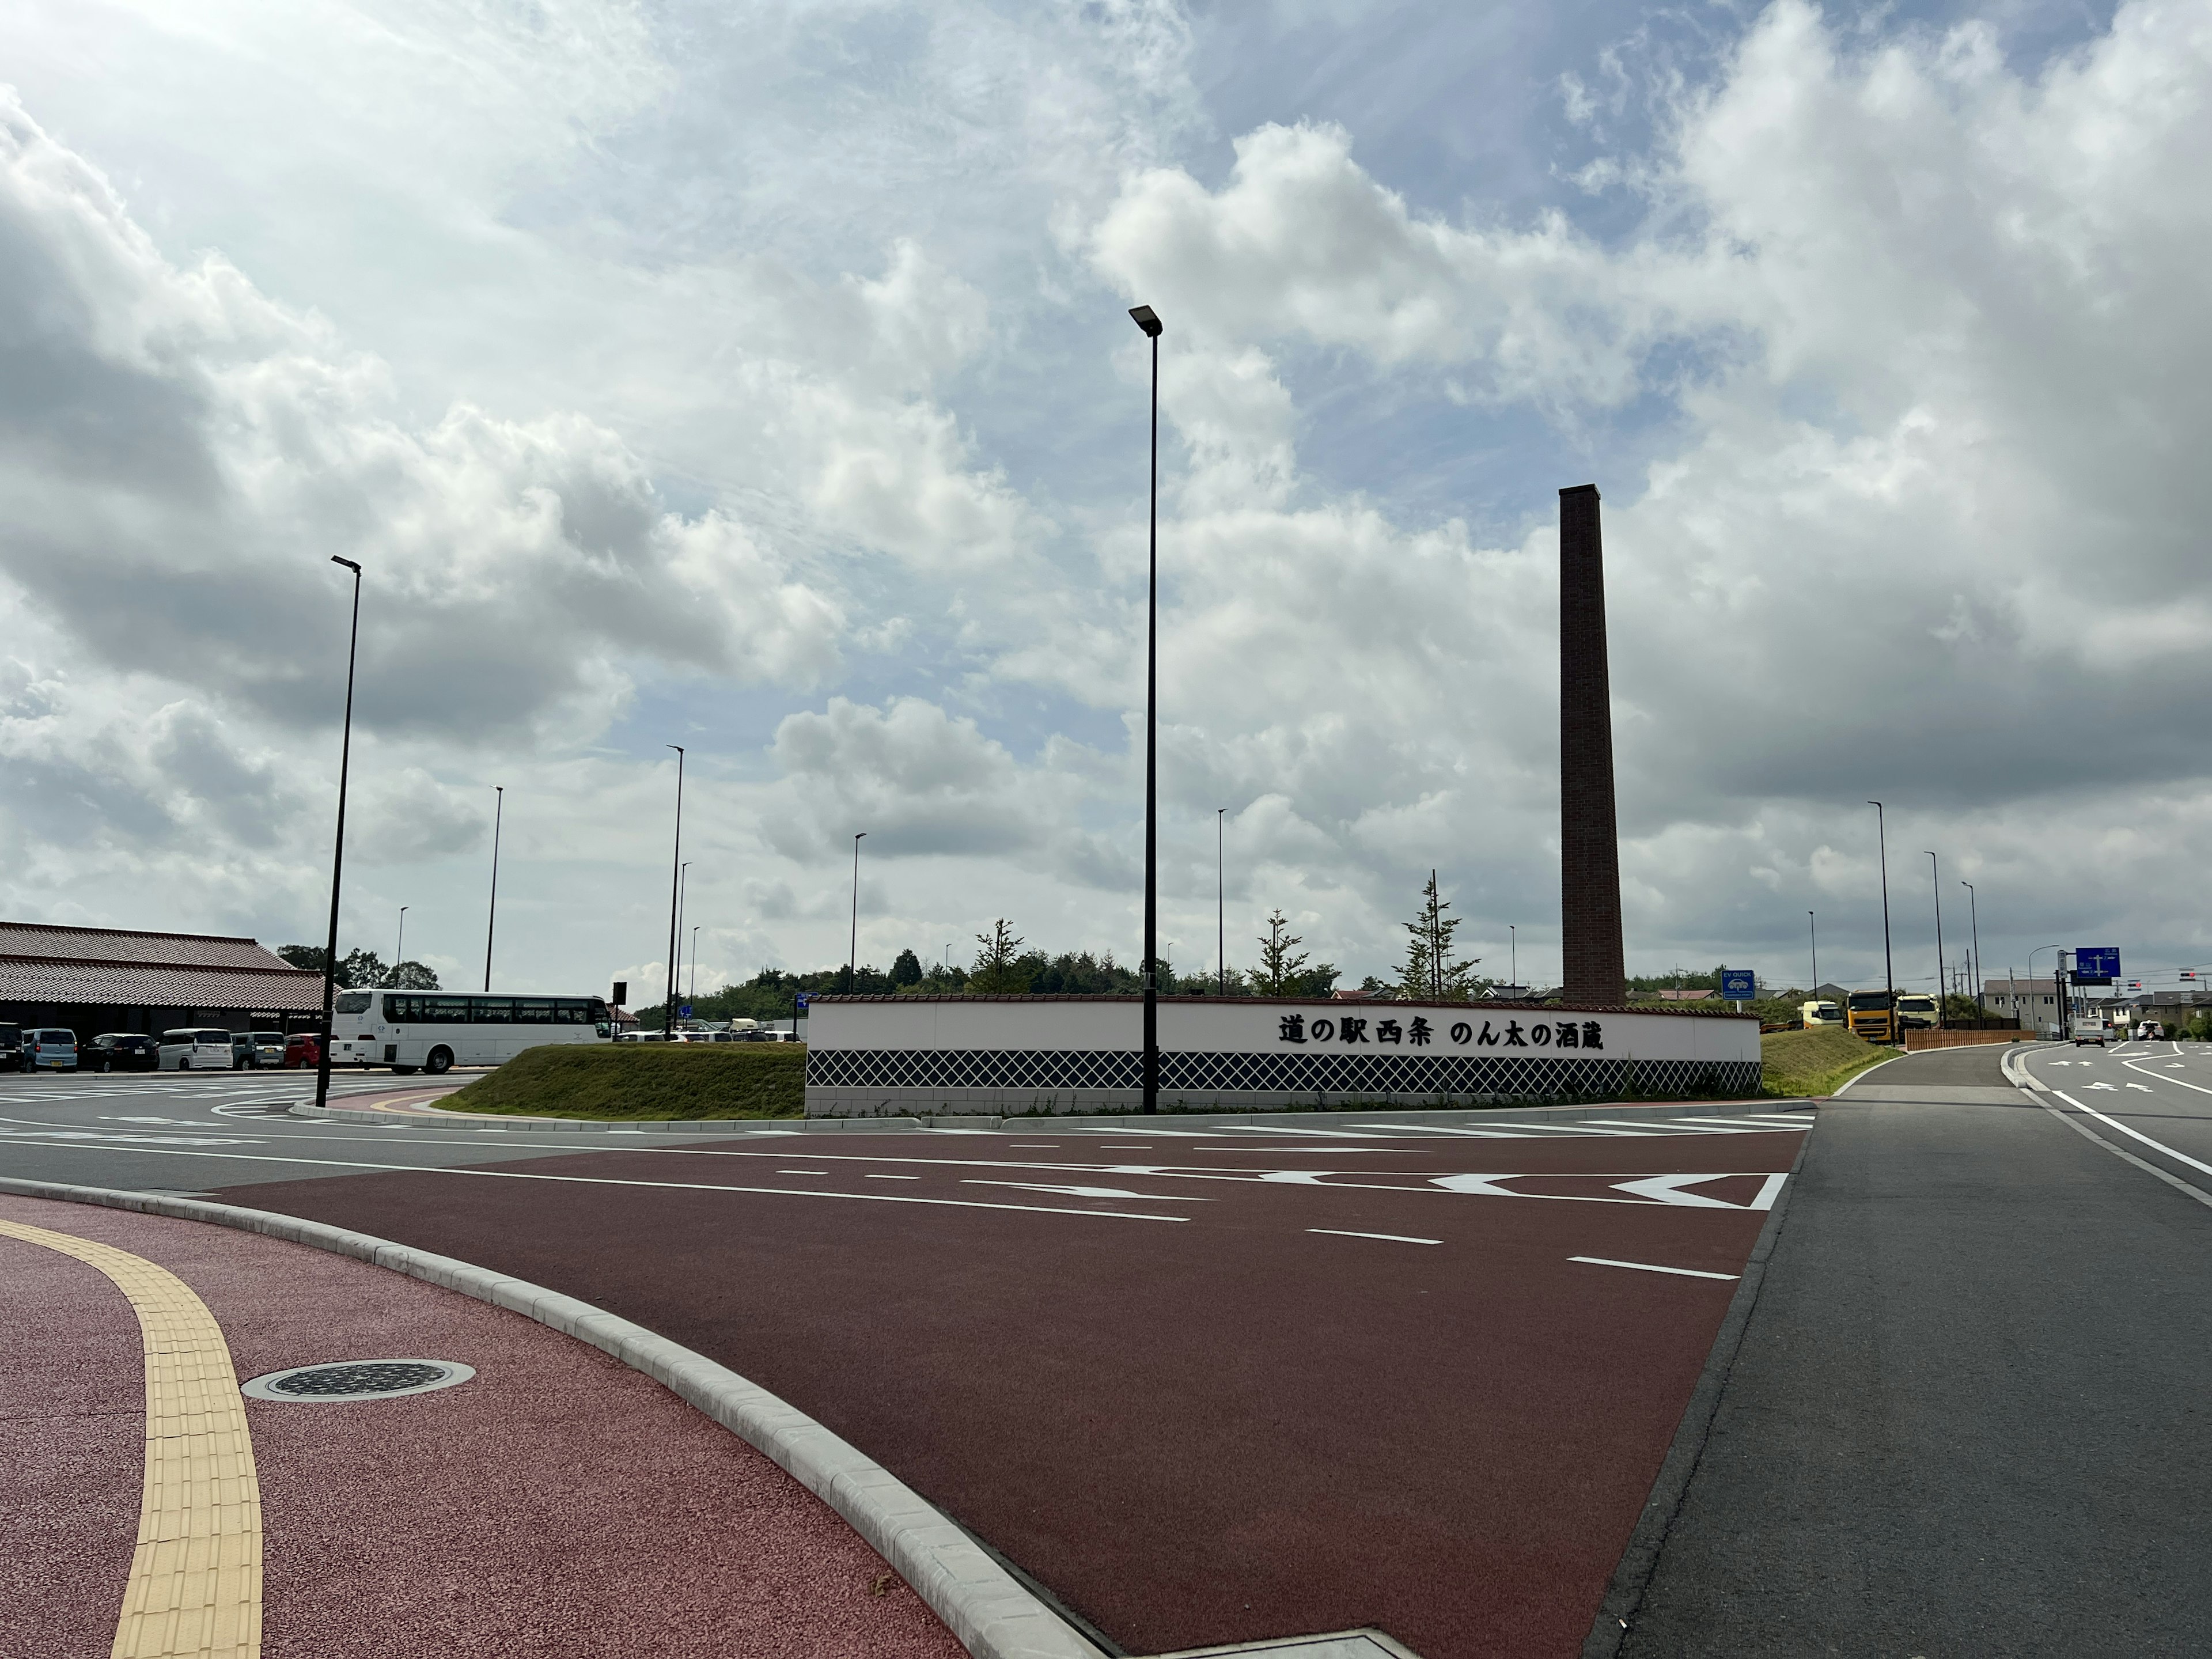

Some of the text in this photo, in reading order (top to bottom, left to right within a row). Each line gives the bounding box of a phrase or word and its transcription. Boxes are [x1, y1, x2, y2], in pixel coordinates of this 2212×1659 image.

[1278, 1013, 1604, 1050] 道の駅西条 のん太の酒蔵
